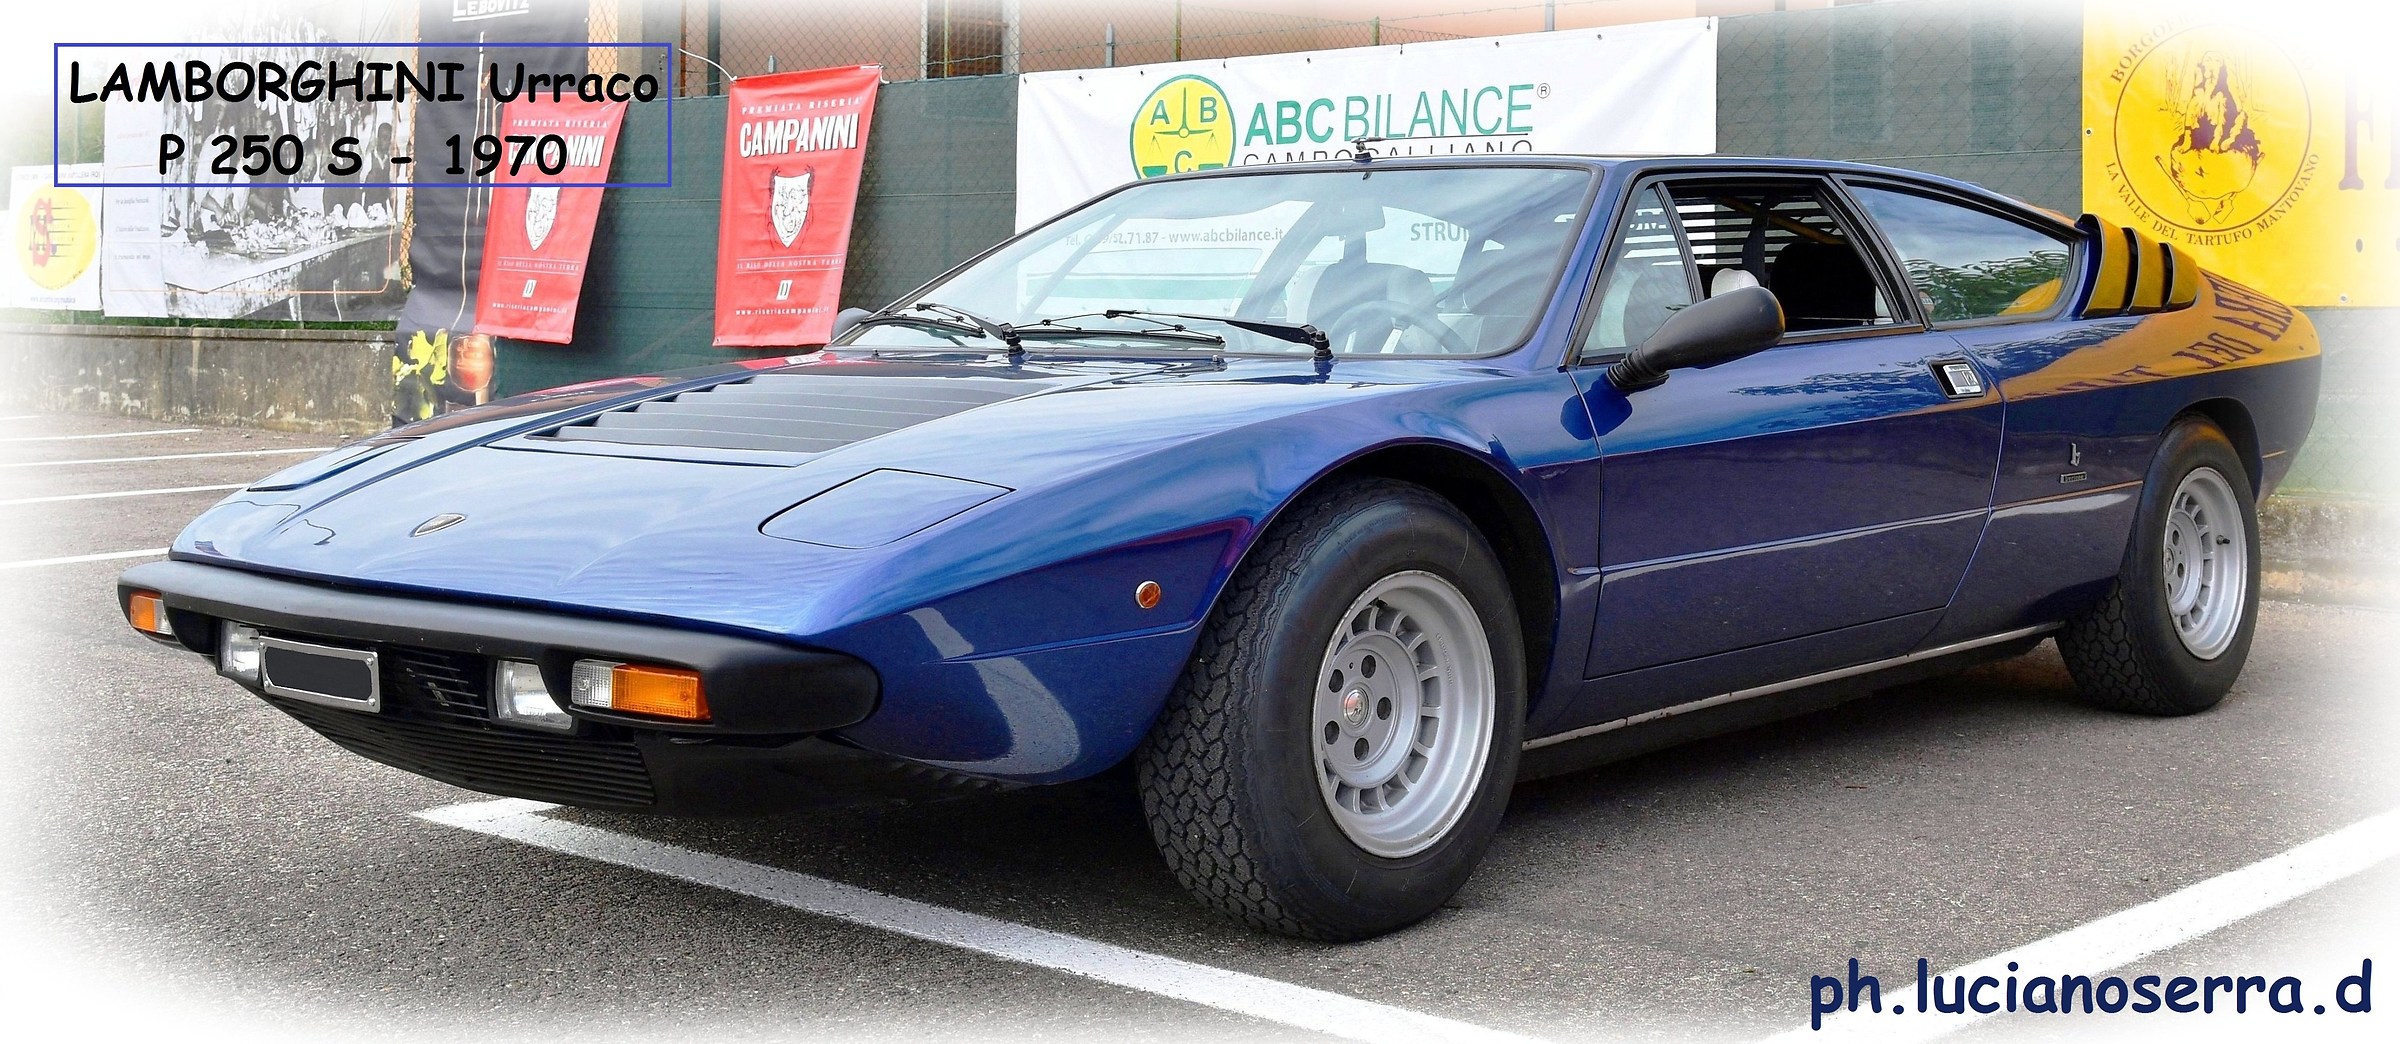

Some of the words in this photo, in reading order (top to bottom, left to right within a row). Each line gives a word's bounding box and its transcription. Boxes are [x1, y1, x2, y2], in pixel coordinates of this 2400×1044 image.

[1150, 99, 1170, 126] A
[1200, 96, 1218, 123] B
[1344, 83, 1535, 142] BILANCE
[740, 112, 859, 159] CAMPANINI
[2106, 162, 2119, 182] LA
[2117, 184, 2151, 224] VALLE
[2151, 220, 2179, 242] DEL
[2187, 228, 2254, 247] TARTUFO
[2256, 153, 2320, 233] MANTOVANO
[1169, 227, 1284, 244] www.abcbilance.it
